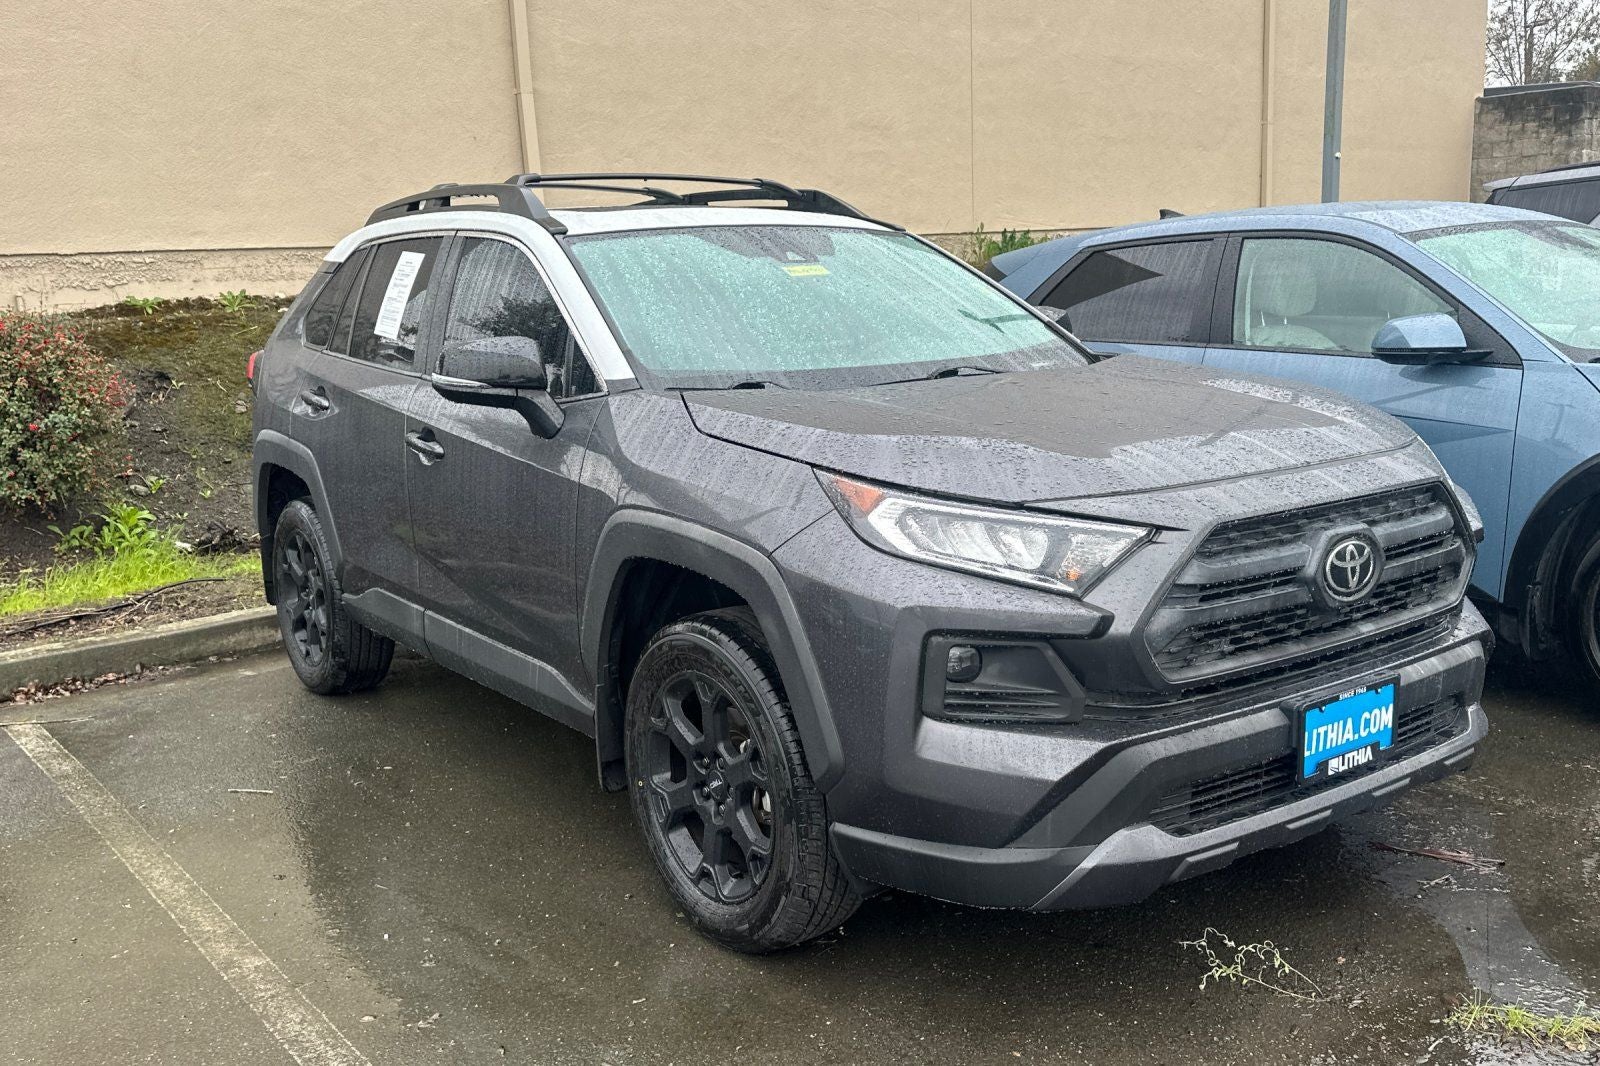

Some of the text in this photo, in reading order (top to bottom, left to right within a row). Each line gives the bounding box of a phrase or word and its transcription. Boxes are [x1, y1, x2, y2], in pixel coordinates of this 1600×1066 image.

[1339, 689, 1355, 701] SINCE
[1304, 703, 1394, 757] LITHIA.COM
[1339, 746, 1373, 772] LITHIA
